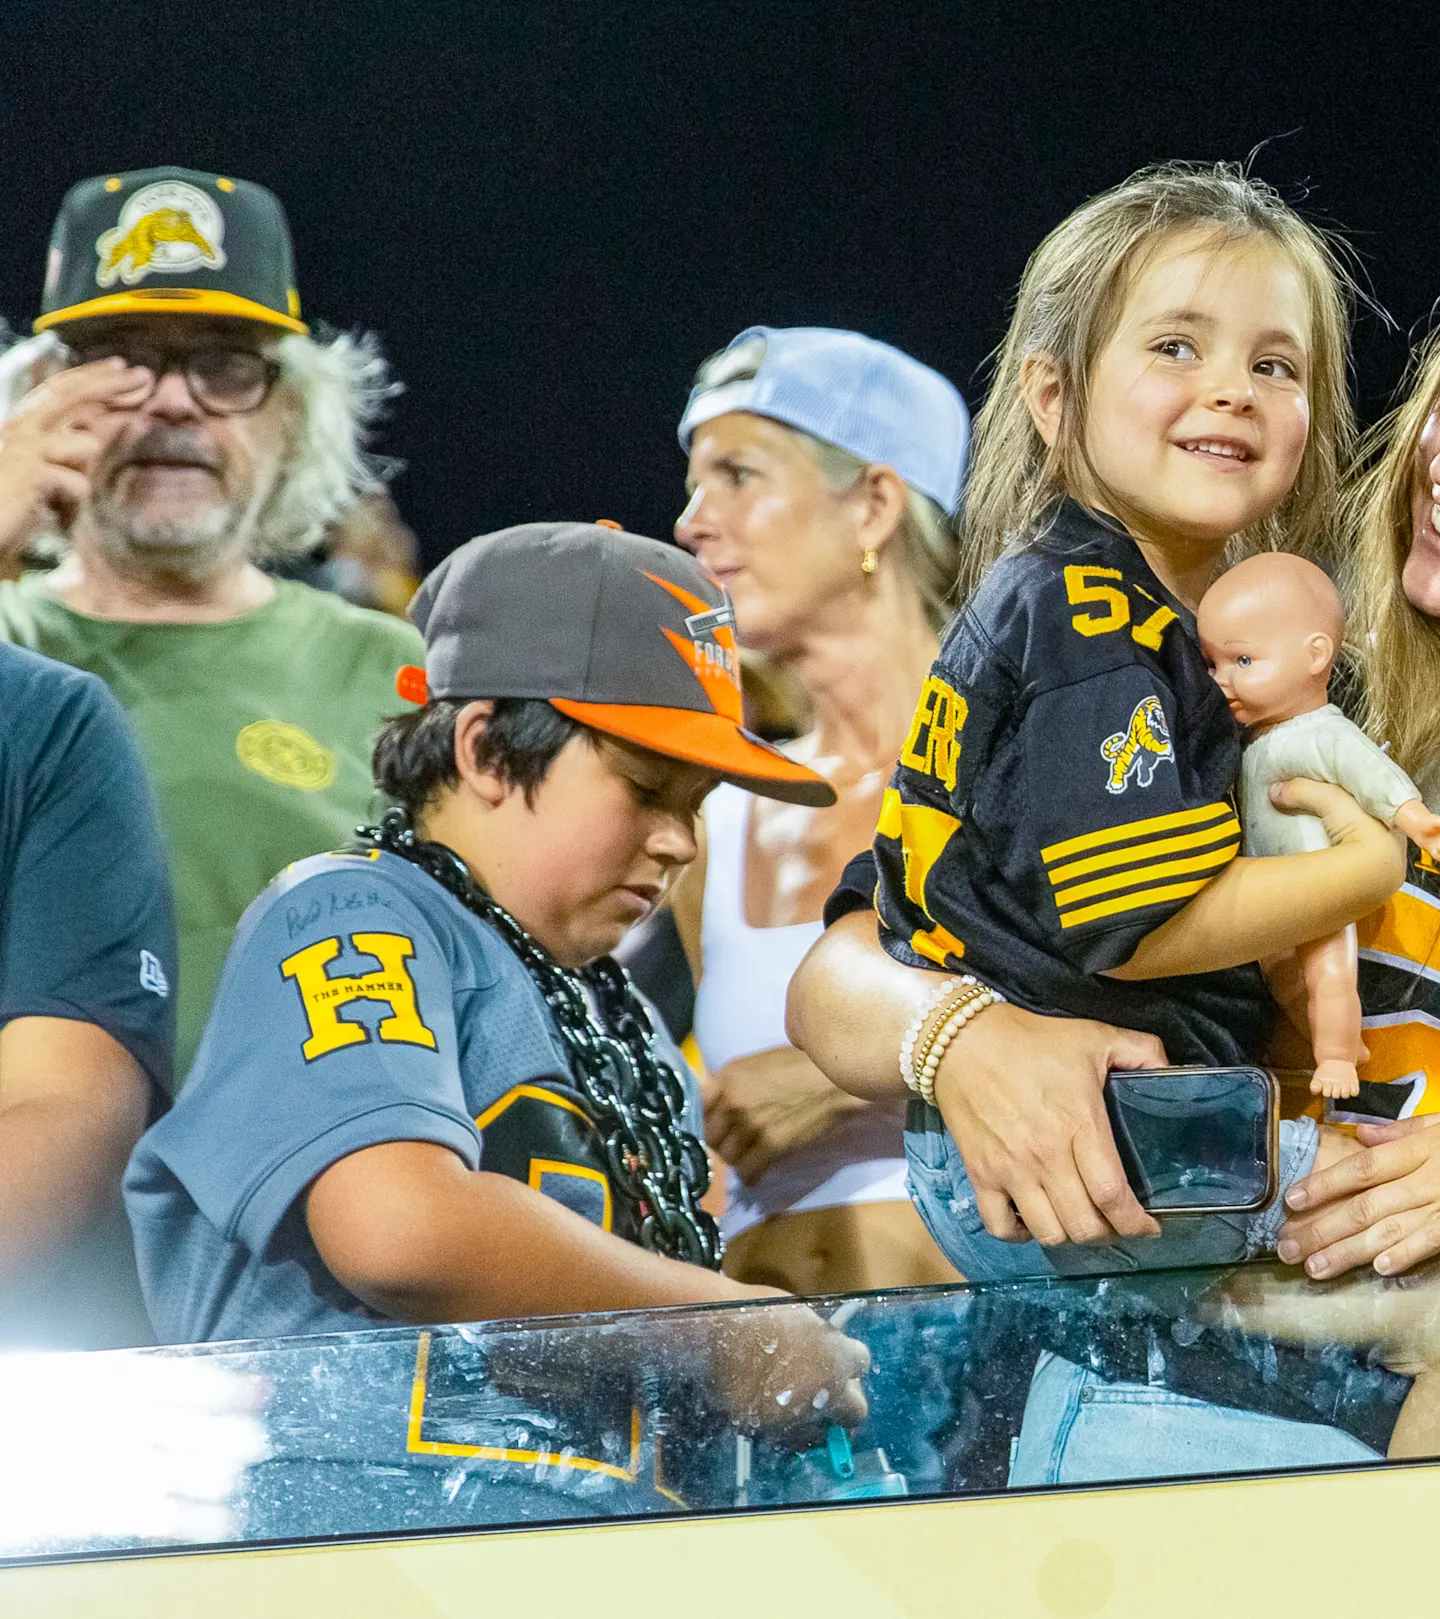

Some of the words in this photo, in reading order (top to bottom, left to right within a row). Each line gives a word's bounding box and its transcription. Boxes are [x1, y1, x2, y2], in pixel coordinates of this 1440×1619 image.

[278, 931, 440, 1065] H
[312, 987, 340, 1003] THE
[343, 981, 404, 994] HAMMER
